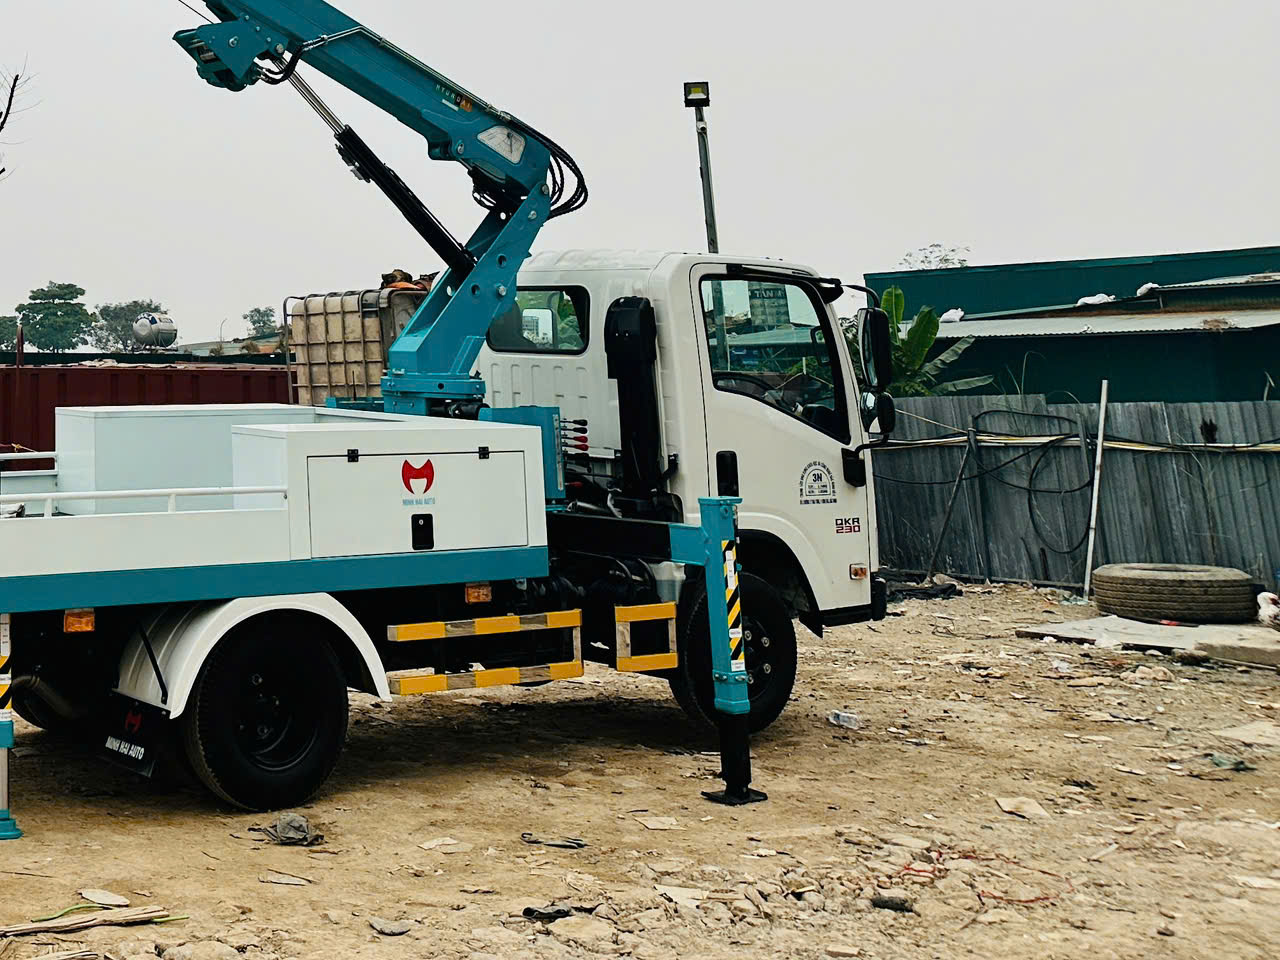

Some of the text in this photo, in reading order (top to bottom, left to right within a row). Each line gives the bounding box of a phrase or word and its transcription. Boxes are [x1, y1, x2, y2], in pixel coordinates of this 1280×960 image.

[435, 84, 471, 109] HYUNDAI
[836, 525, 861, 534] 230
[128, 744, 145, 760] AUTO
